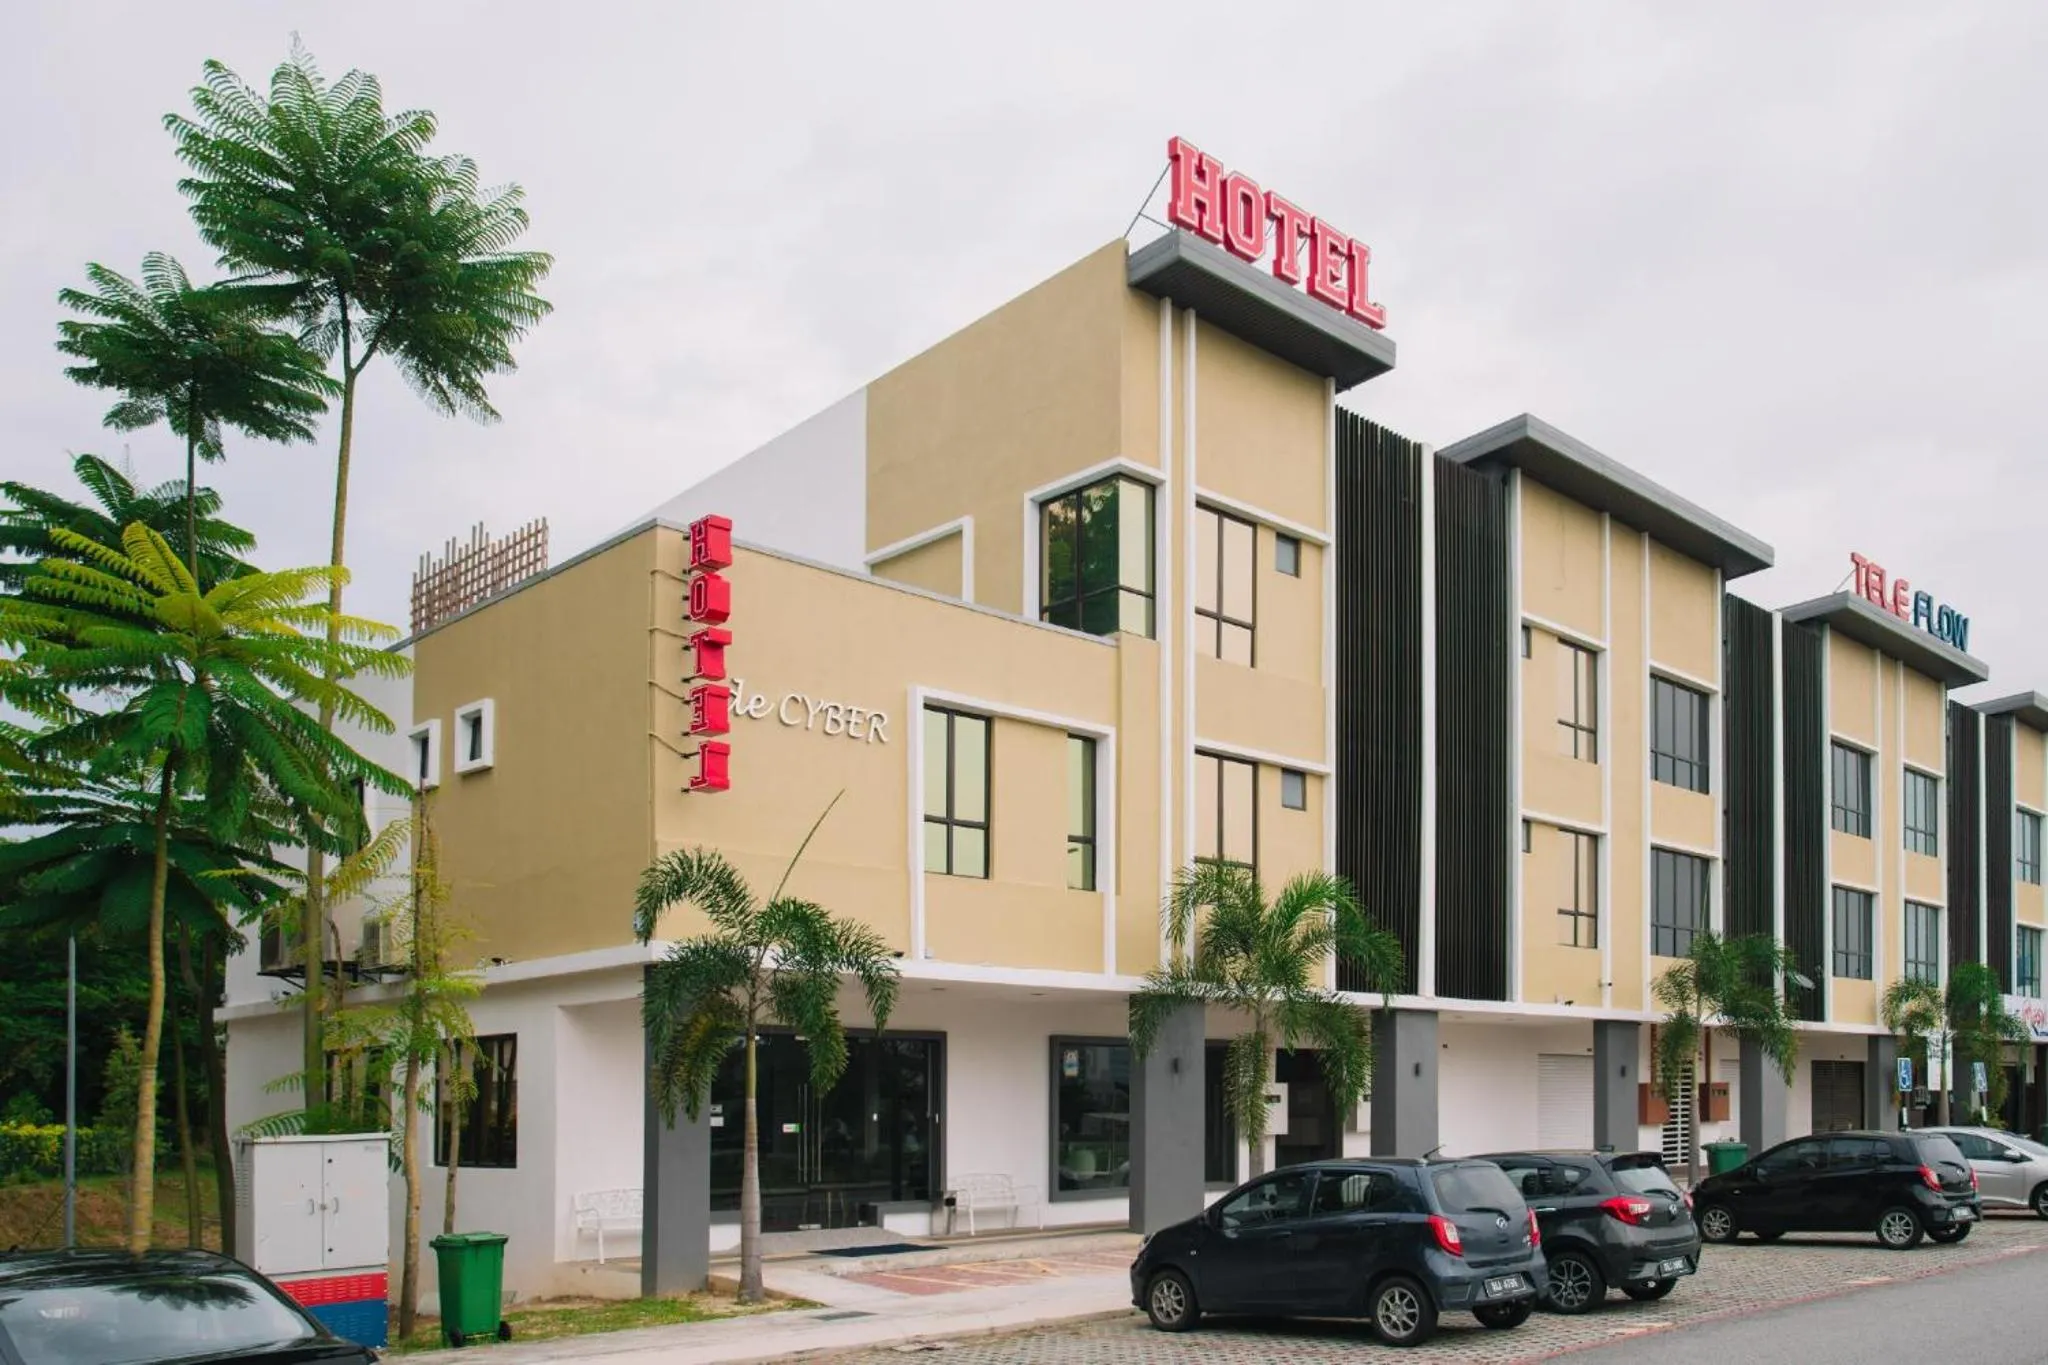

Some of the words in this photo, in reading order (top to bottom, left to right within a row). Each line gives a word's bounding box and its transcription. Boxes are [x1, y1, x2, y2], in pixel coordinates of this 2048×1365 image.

[1167, 135, 1387, 330] HOTEL
[688, 514, 732, 793] HOTEL
[1850, 551, 1910, 622] TELE
[1913, 589, 1970, 653] FLOW
[779, 692, 890, 744] CYBER
